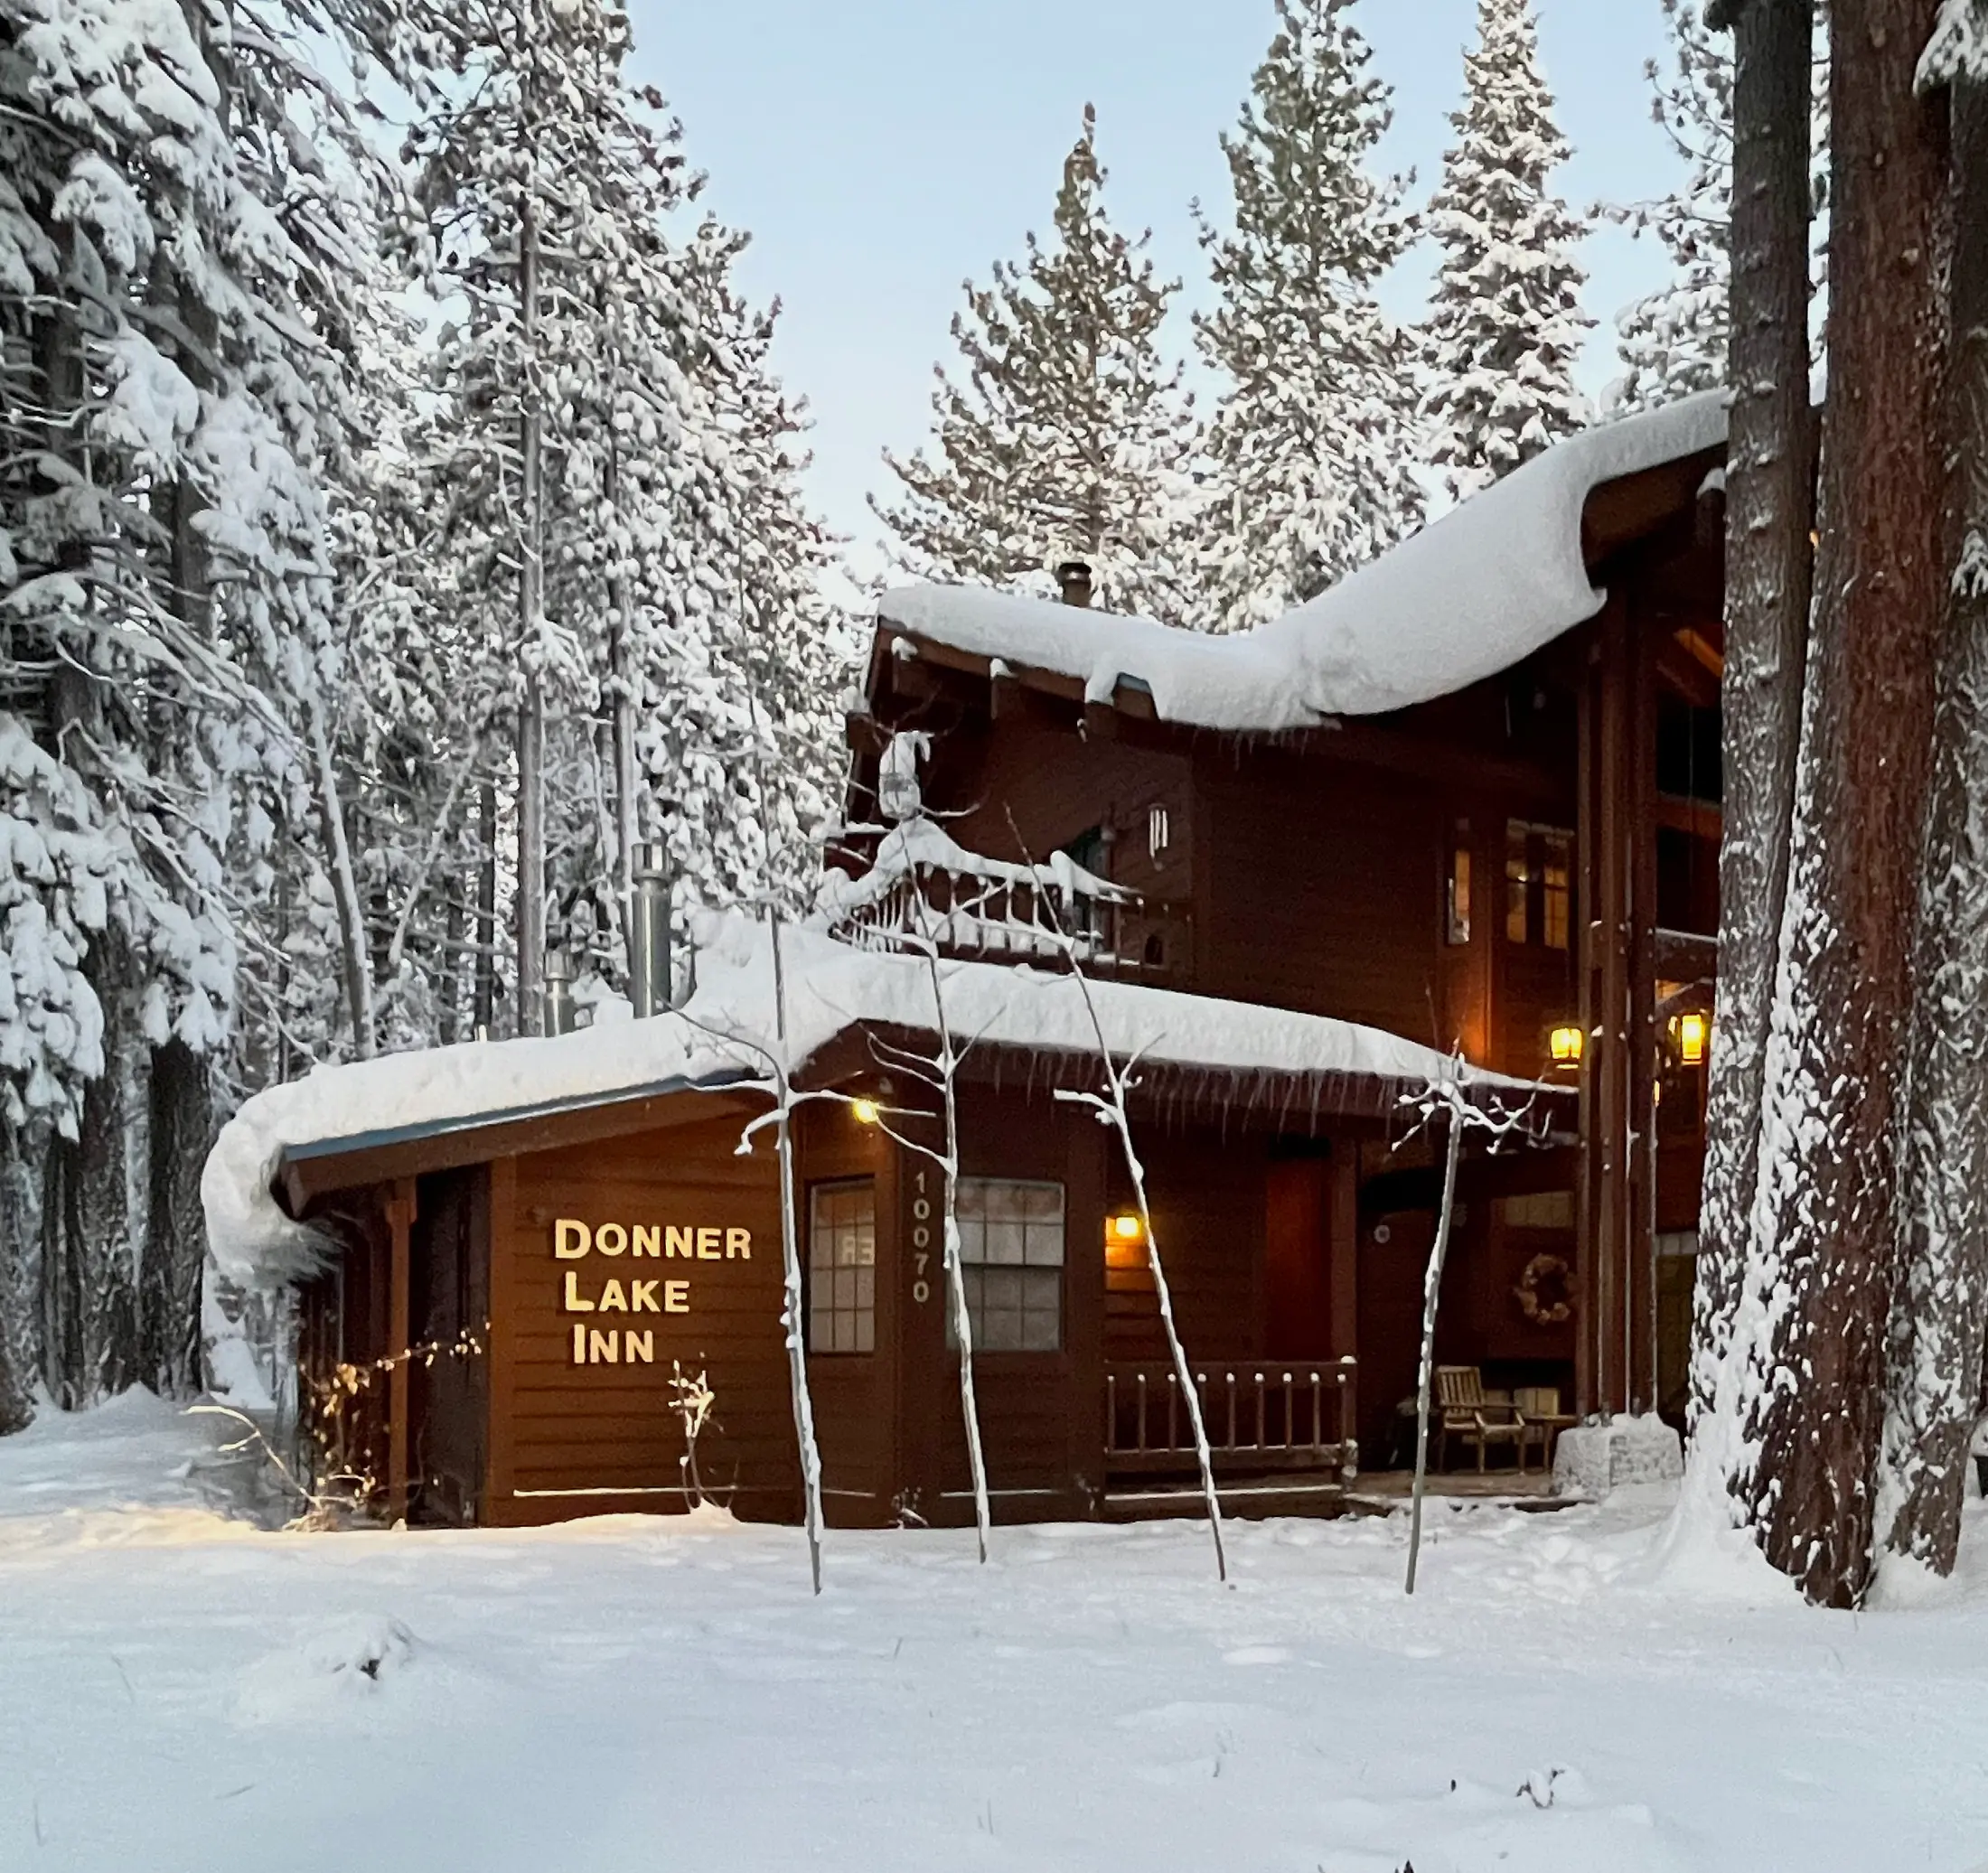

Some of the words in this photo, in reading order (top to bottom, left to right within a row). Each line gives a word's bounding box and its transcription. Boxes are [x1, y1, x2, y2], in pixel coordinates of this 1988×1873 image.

[555, 1219, 752, 1260] DONNER
[913, 1171, 931, 1303] 10070
[565, 1270, 690, 1313] LAKE
[573, 1324, 654, 1364] INN
